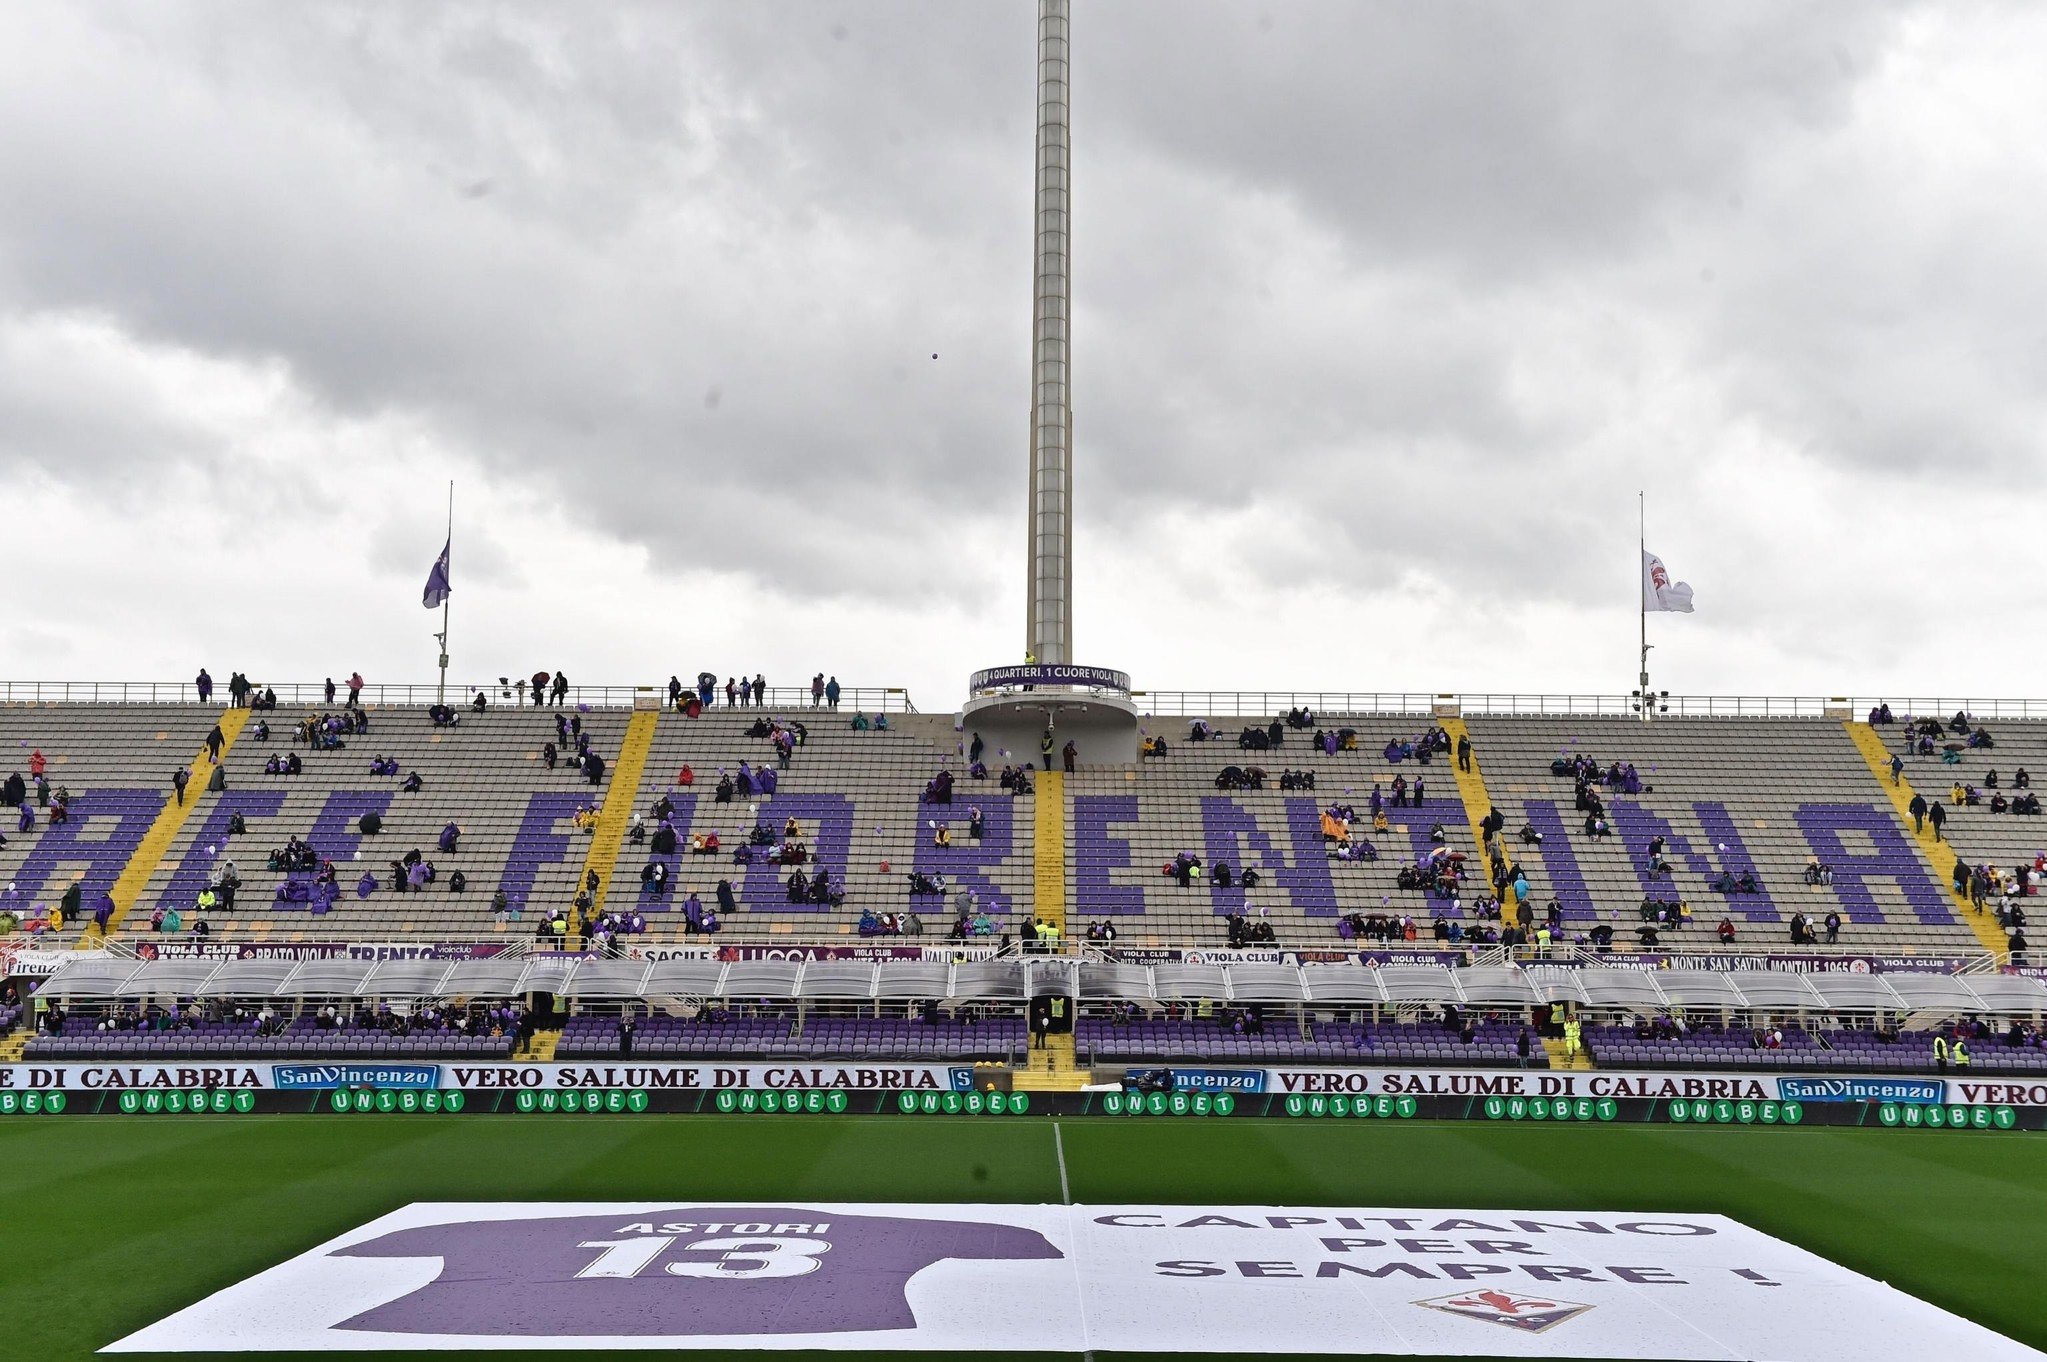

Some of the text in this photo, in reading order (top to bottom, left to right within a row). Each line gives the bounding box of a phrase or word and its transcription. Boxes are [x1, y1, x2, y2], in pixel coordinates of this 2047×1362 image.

[994, 667, 1044, 680] QUARTIERI,
[1046, 667, 1051, 677] 1
[1054, 667, 1090, 679] CUORE
[1091, 669, 1112, 681] VIOLA
[157, 945, 240, 954] VIOLA CLUB
[854, 949, 892, 957] VIOLA CLUB
[1205, 952, 1244, 963] VIOLA
[1251, 953, 1279, 963] CLUB
[1299, 952, 1324, 961] VIOLA
[1326, 953, 1345, 961] CLUB
[1391, 955, 1436, 963] VIOLA CLUB
[1670, 956, 1707, 971] MONTE
[1709, 956, 1731, 972] SAN
[1882, 959, 1914, 967] VIOLA
[28, 1068, 67, 1088] DI
[80, 1068, 263, 1088] CALABRIA
[280, 1066, 429, 1084] SanVincenzo
[452, 1068, 940, 1089] VERO SALUME DI CALABRIA
[1278, 1073, 1769, 1099] VERO SALUME DI CALABRIA
[1785, 1079, 1936, 1099] SanVincenzo
[1958, 1083, 2047, 1105] VERO
[122, 1092, 250, 1110] UNIBET
[334, 1092, 460, 1110] UNIBET
[519, 1092, 644, 1110] UNIBET
[719, 1092, 844, 1110] UNIBET
[901, 1093, 1026, 1111] UNIBET
[1106, 1094, 1230, 1112] UNIBET
[1288, 1097, 1413, 1115] UNIBET
[1488, 1100, 1613, 1118] UNIBET
[1672, 1102, 1798, 1120] UNIBET
[1881, 1106, 2011, 1125] UNIBET
[613, 1222, 831, 1235] ASTORI
[1093, 1214, 1718, 1237] CAPITANO
[1318, 1237, 1552, 1256] PER
[573, 1236, 833, 1279] 13
[1155, 1260, 1690, 1285] SEMPRE
